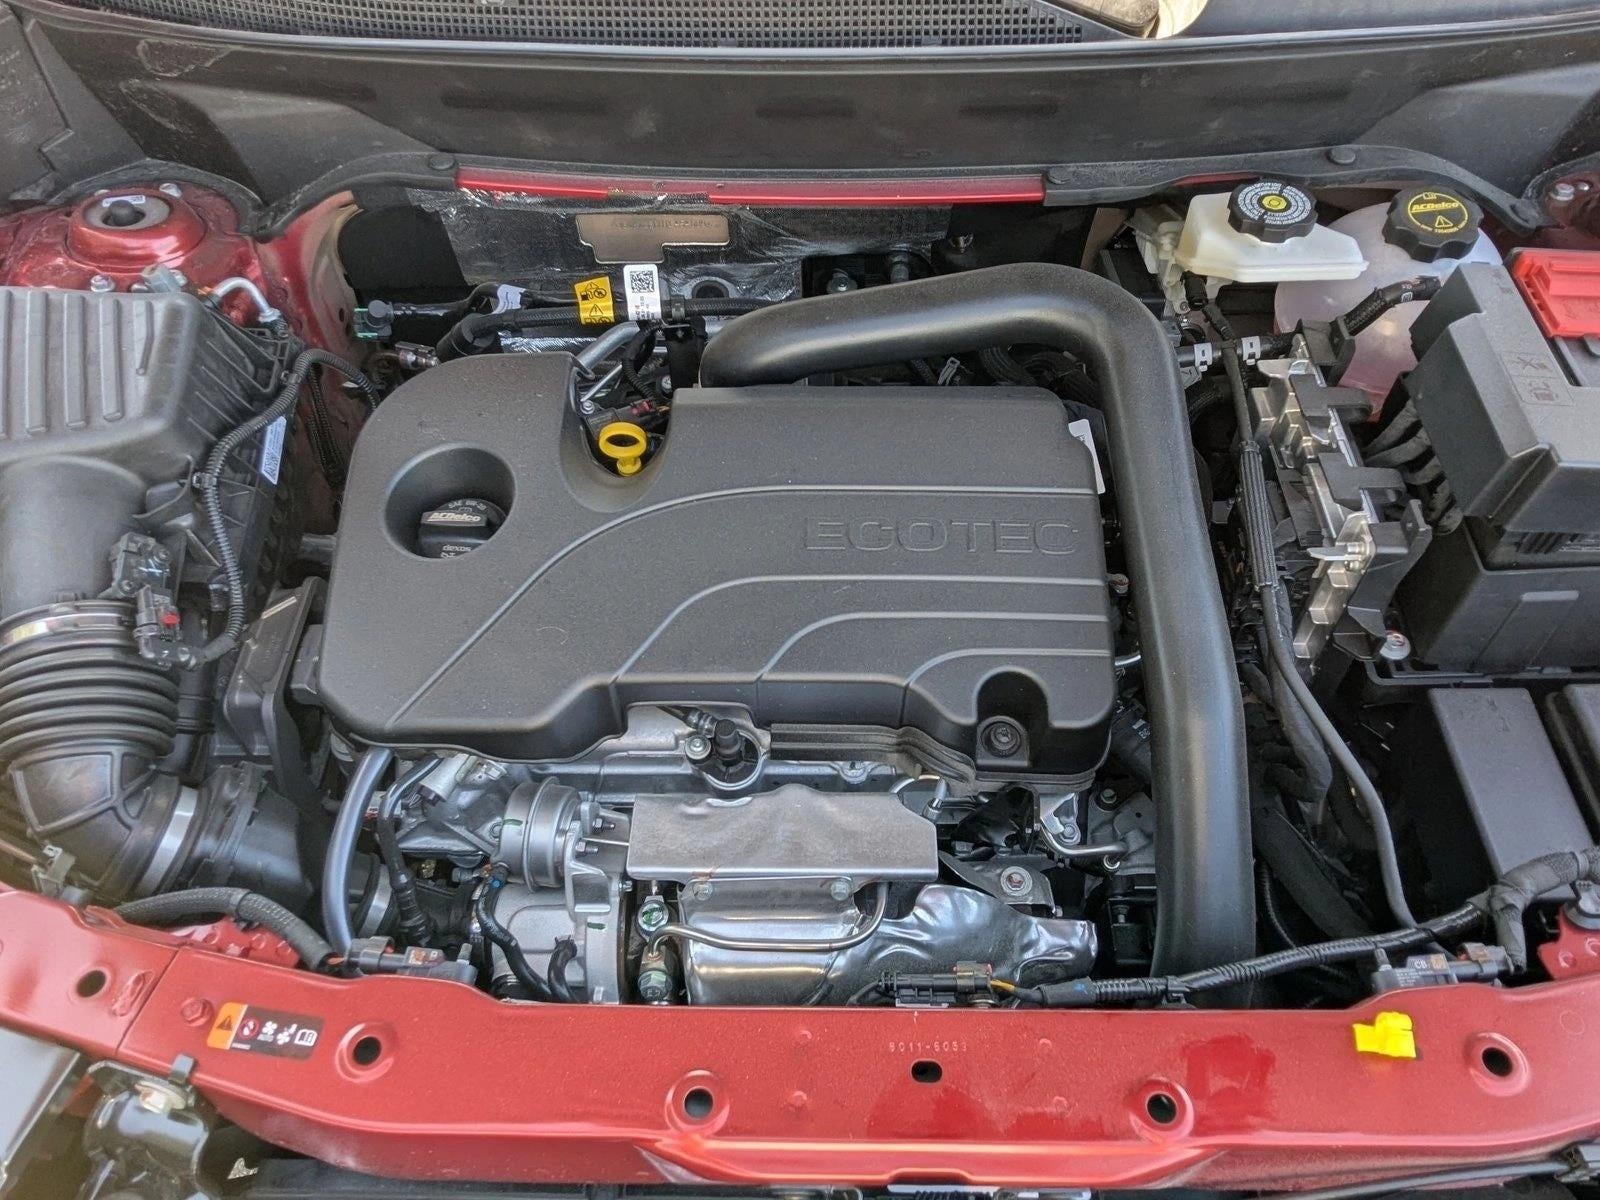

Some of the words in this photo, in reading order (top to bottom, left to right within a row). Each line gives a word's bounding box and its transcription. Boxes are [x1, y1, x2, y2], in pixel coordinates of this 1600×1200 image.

[1411, 201, 1460, 213] ACDelco
[427, 512, 481, 522] ACDelco
[804, 517, 1079, 554] ECOTEC
